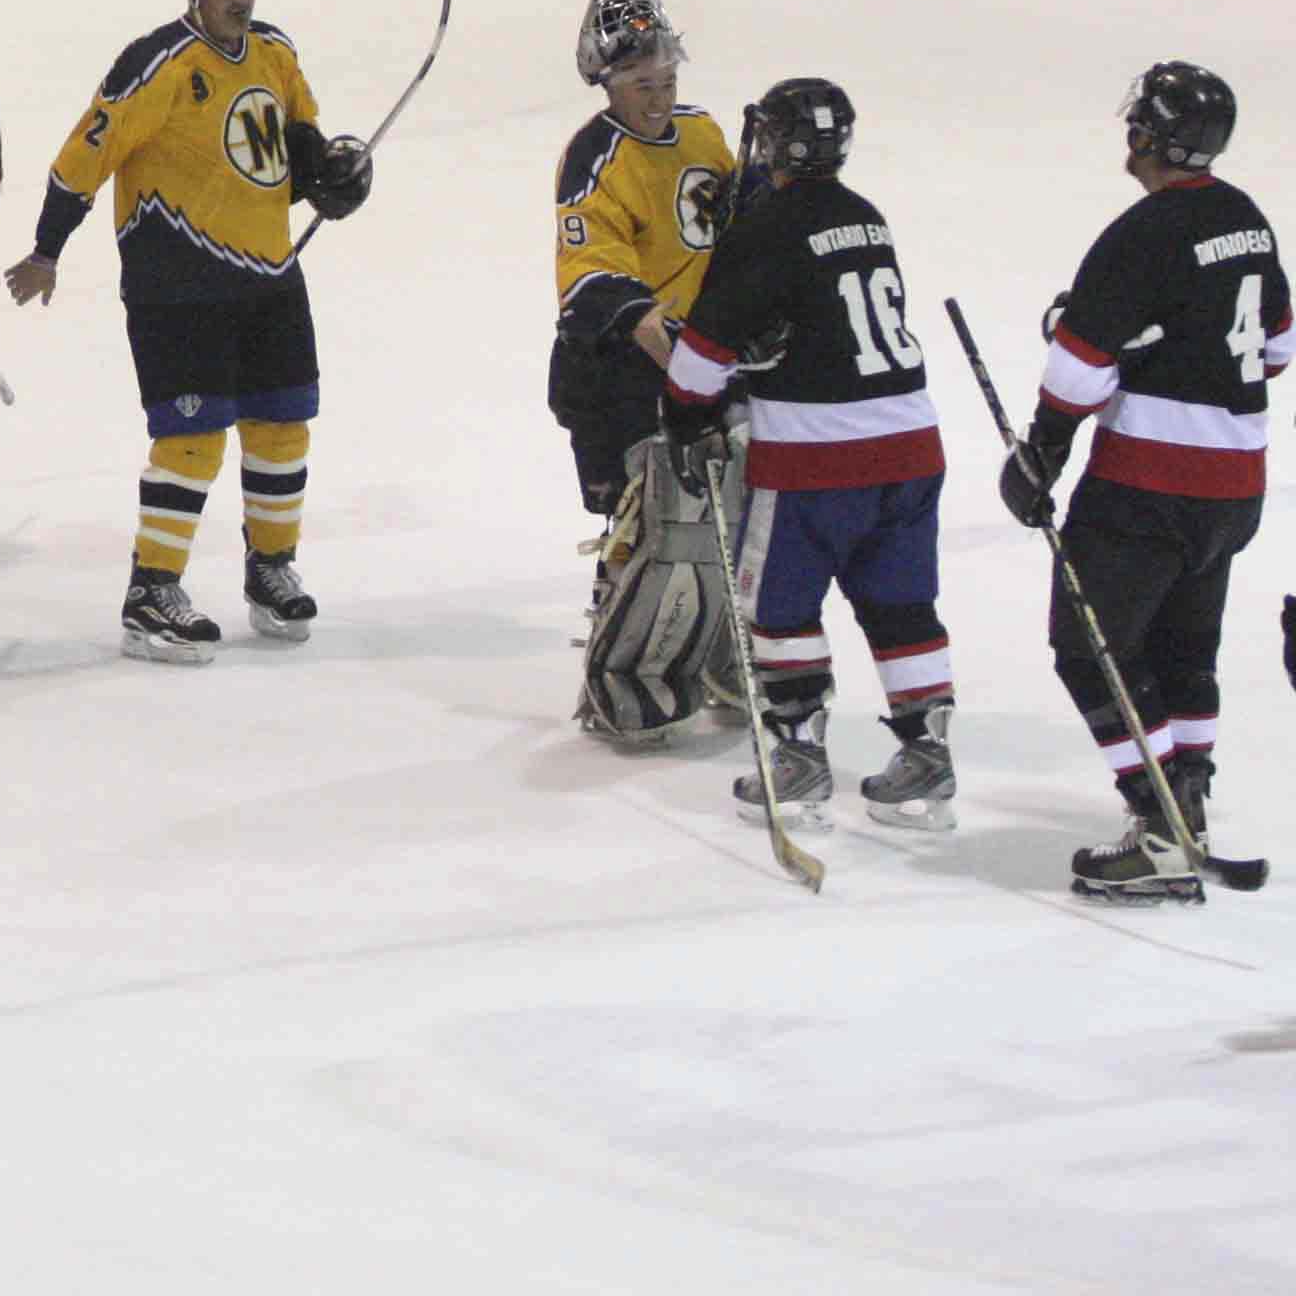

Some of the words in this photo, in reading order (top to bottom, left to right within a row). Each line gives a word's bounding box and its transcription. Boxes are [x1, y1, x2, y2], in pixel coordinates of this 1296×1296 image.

[84, 108, 109, 147] 2
[240, 103, 286, 171] M
[808, 224, 868, 256] ONTARIO
[838, 267, 923, 376] 16
[1225, 273, 1265, 384] 4
